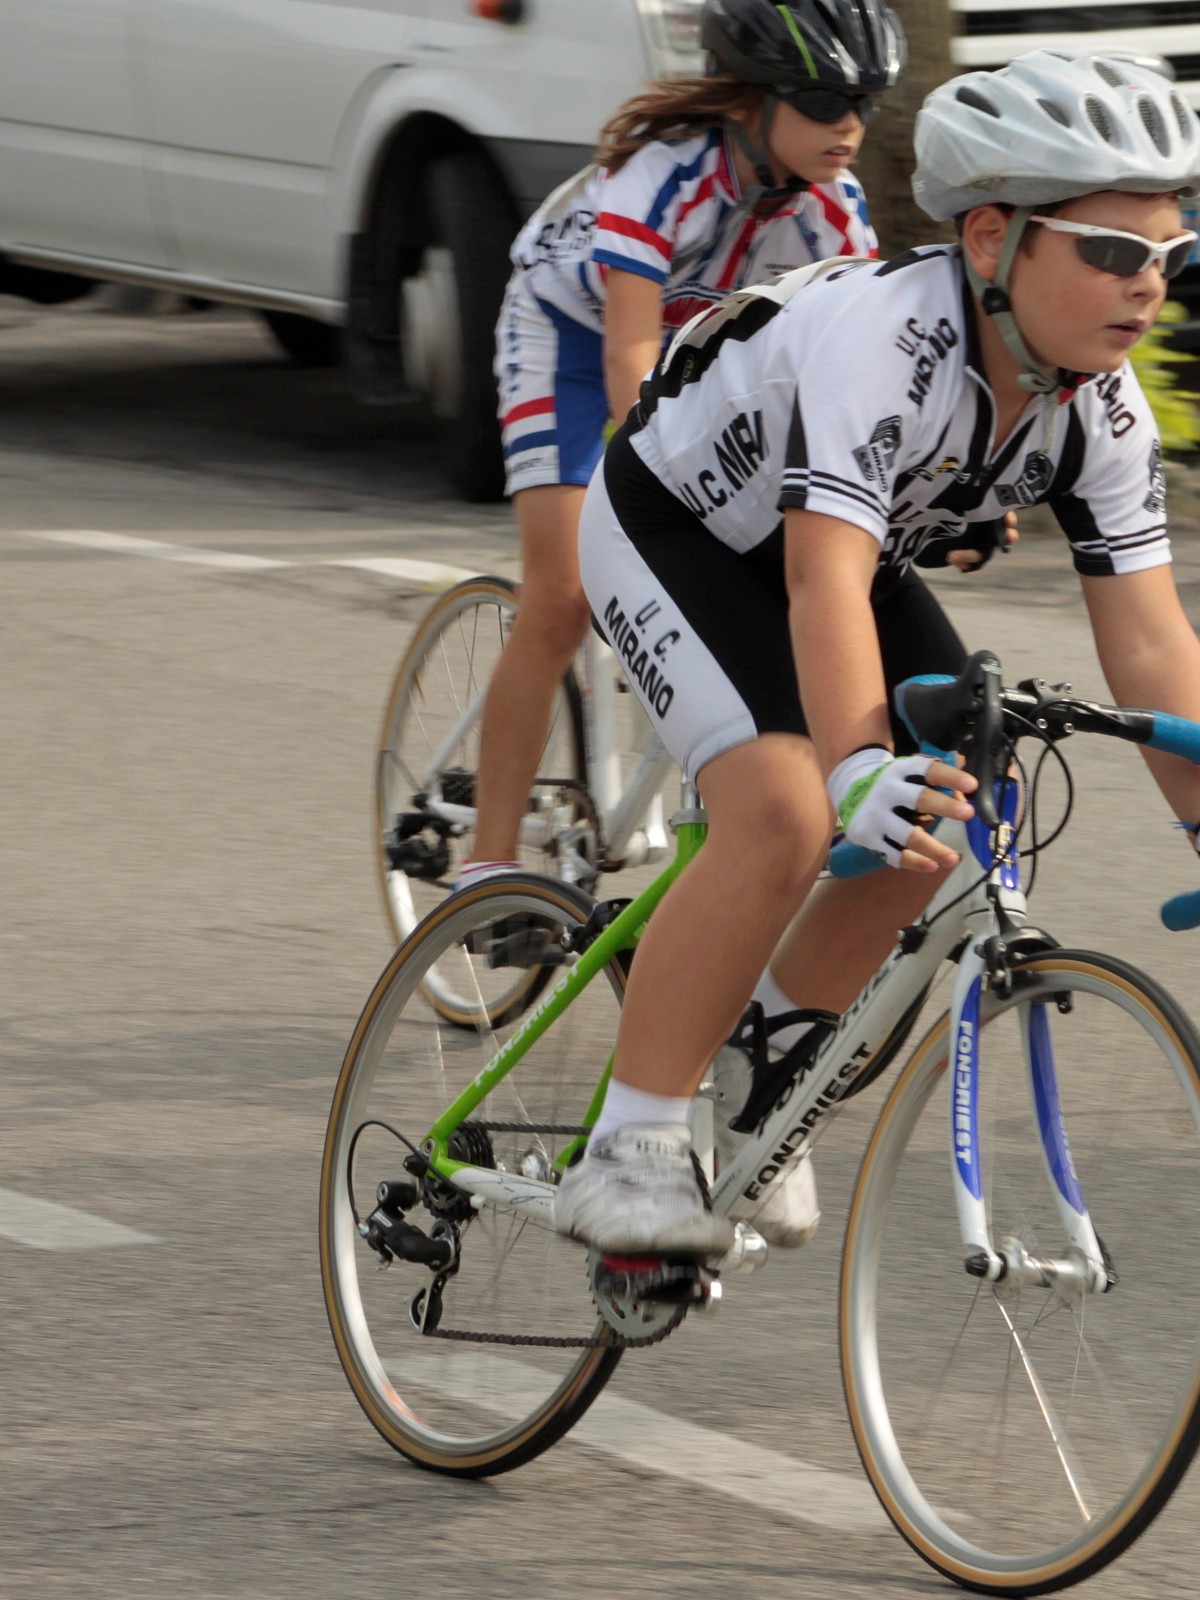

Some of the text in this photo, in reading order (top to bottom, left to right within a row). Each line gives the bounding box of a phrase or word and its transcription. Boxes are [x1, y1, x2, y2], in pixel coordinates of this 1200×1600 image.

[604, 595, 674, 719] MIRANO
[743, 1041, 874, 1201] FONDRIEST
[955, 1020, 974, 1165] FONDRIEST
